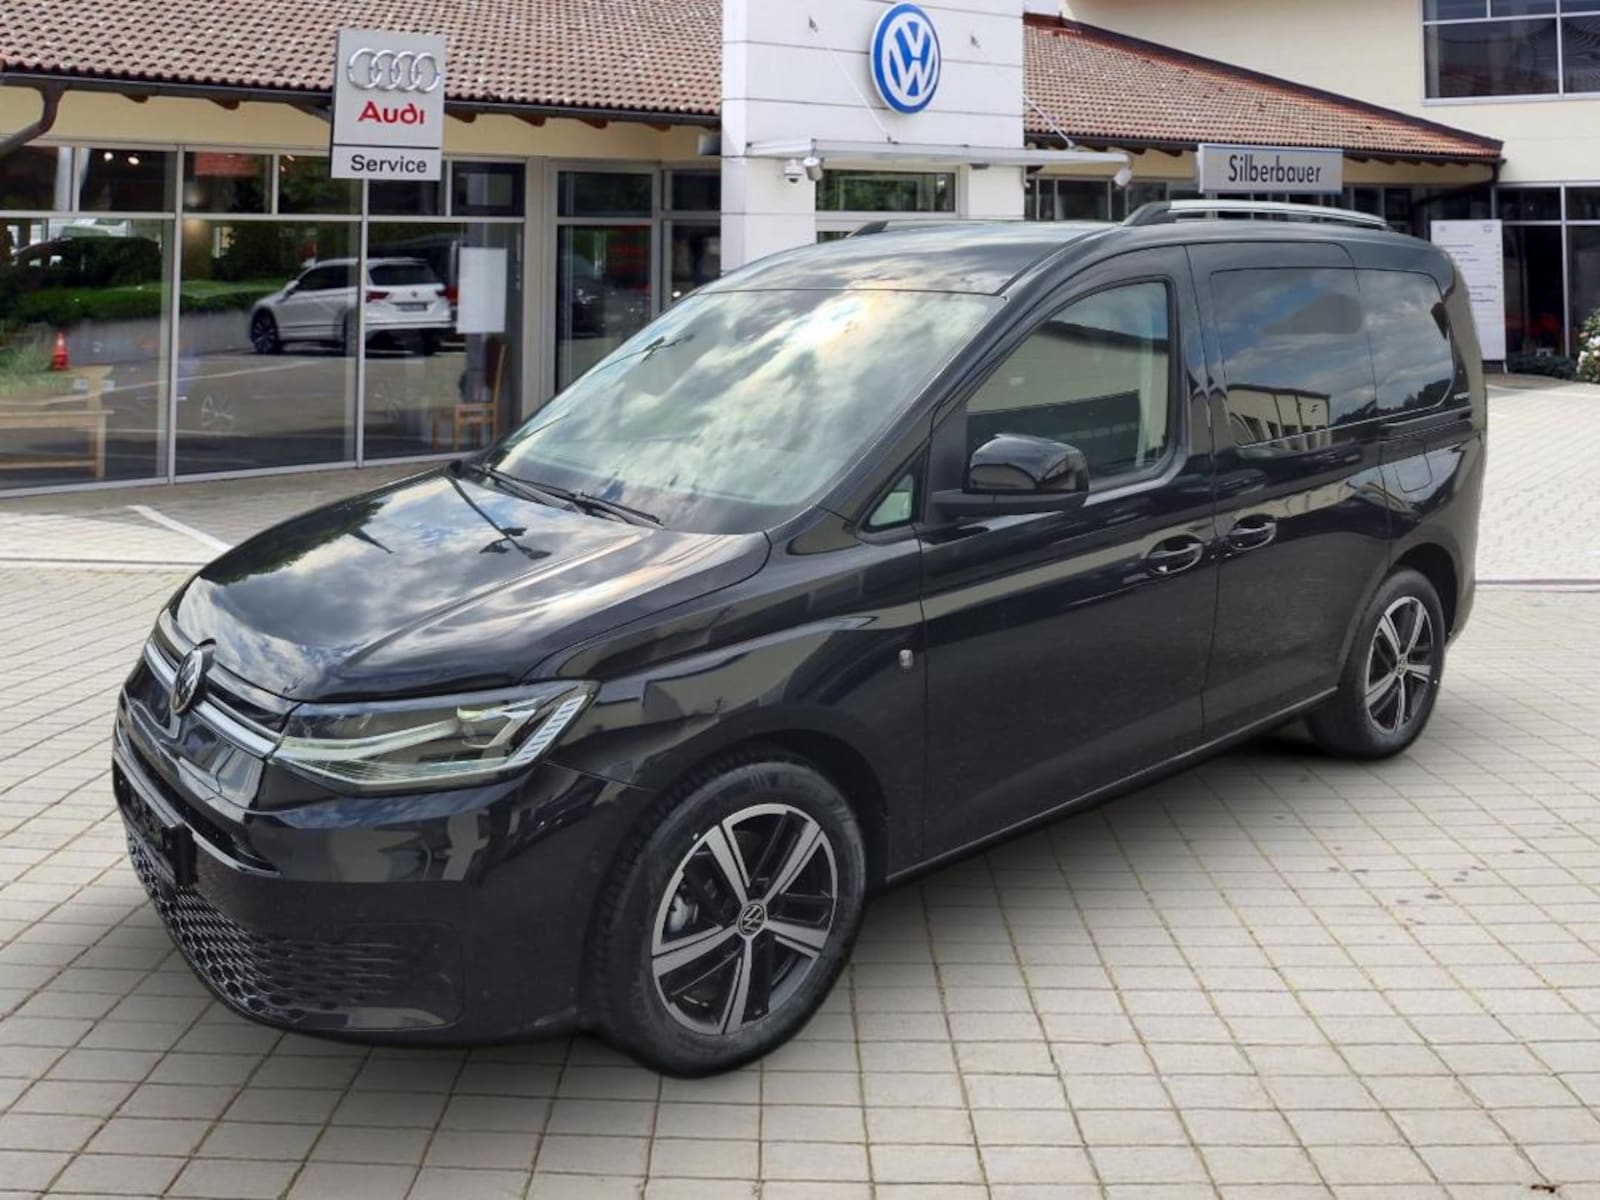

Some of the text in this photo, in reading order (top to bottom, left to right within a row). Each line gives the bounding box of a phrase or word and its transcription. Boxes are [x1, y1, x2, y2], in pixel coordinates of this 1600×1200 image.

[357, 100, 425, 125] Audi
[350, 154, 427, 173] Service
[1227, 153, 1322, 183] Silberbauer
